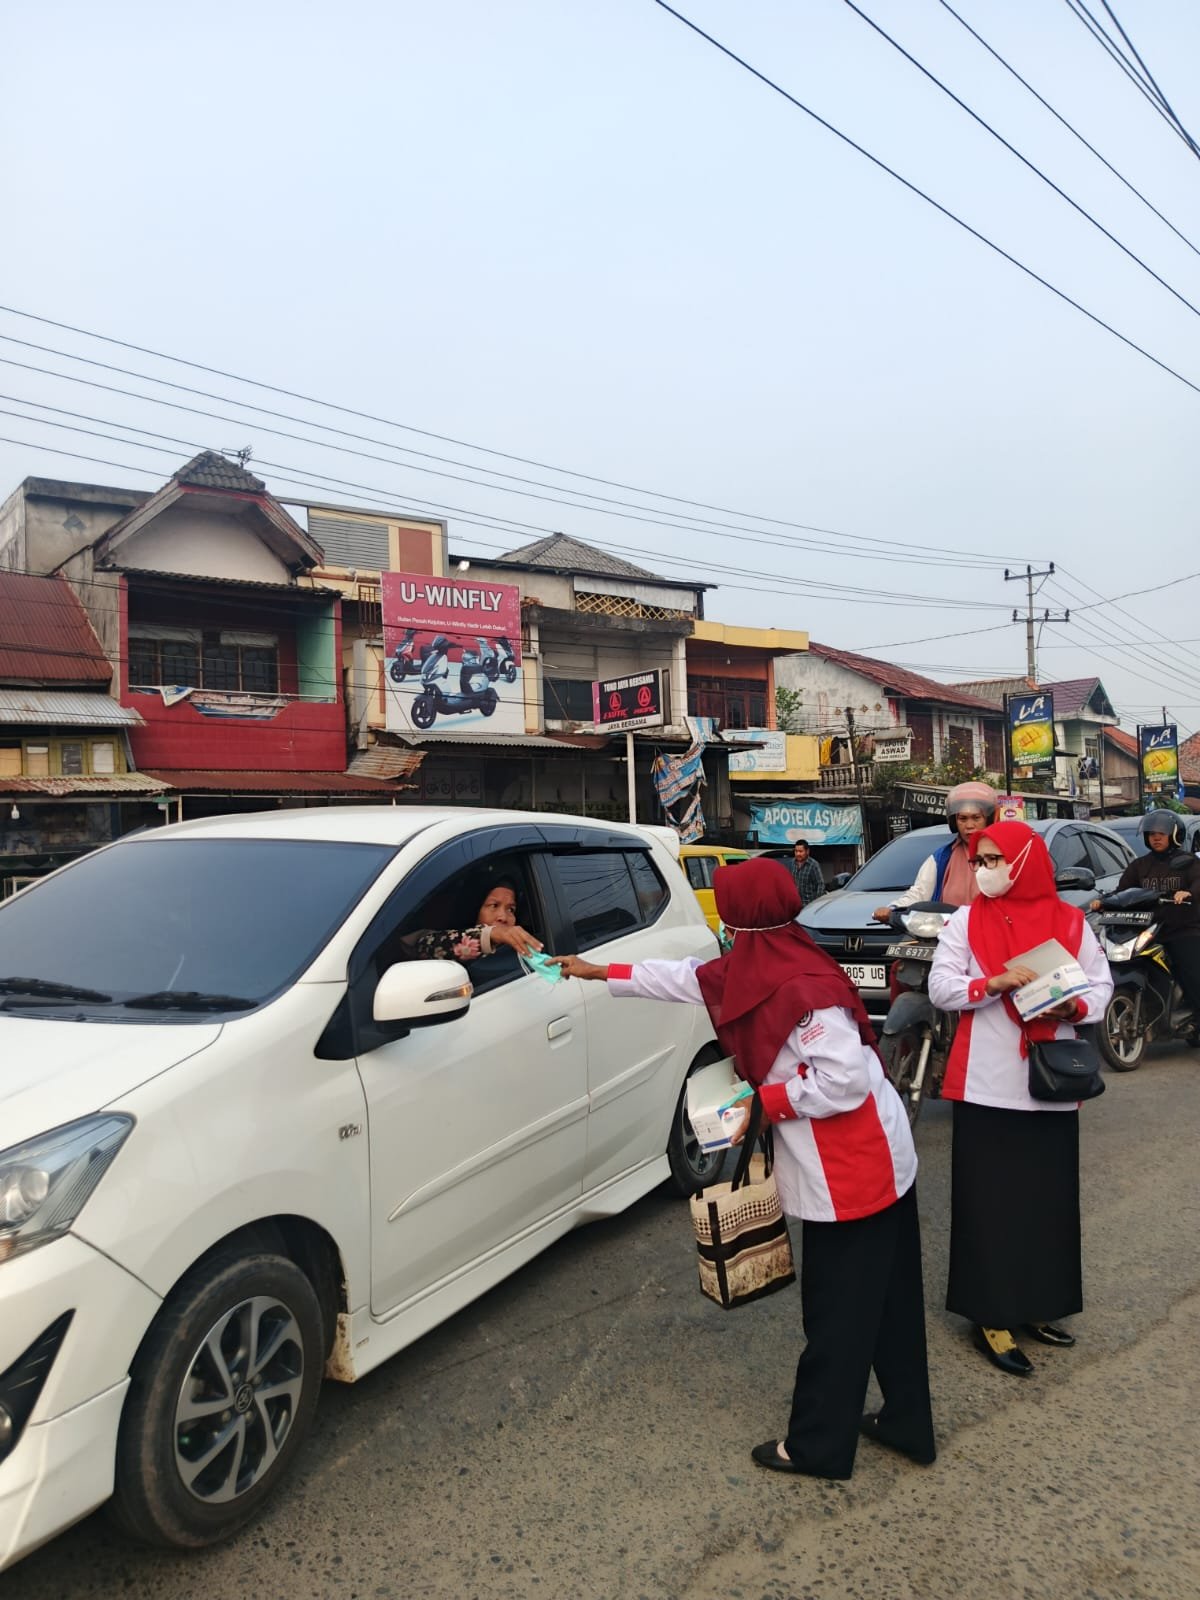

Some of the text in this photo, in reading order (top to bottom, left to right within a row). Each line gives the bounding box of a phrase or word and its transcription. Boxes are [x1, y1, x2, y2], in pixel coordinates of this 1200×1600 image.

[400, 582, 503, 612] U-WINFLY
[1019, 696, 1045, 720] LA
[881, 747, 906, 755] ASWAD
[912, 793, 937, 805] TOKO
[763, 807, 812, 826] APOTEK
[905, 947, 930, 958] 6977
[870, 967, 884, 980] UG
